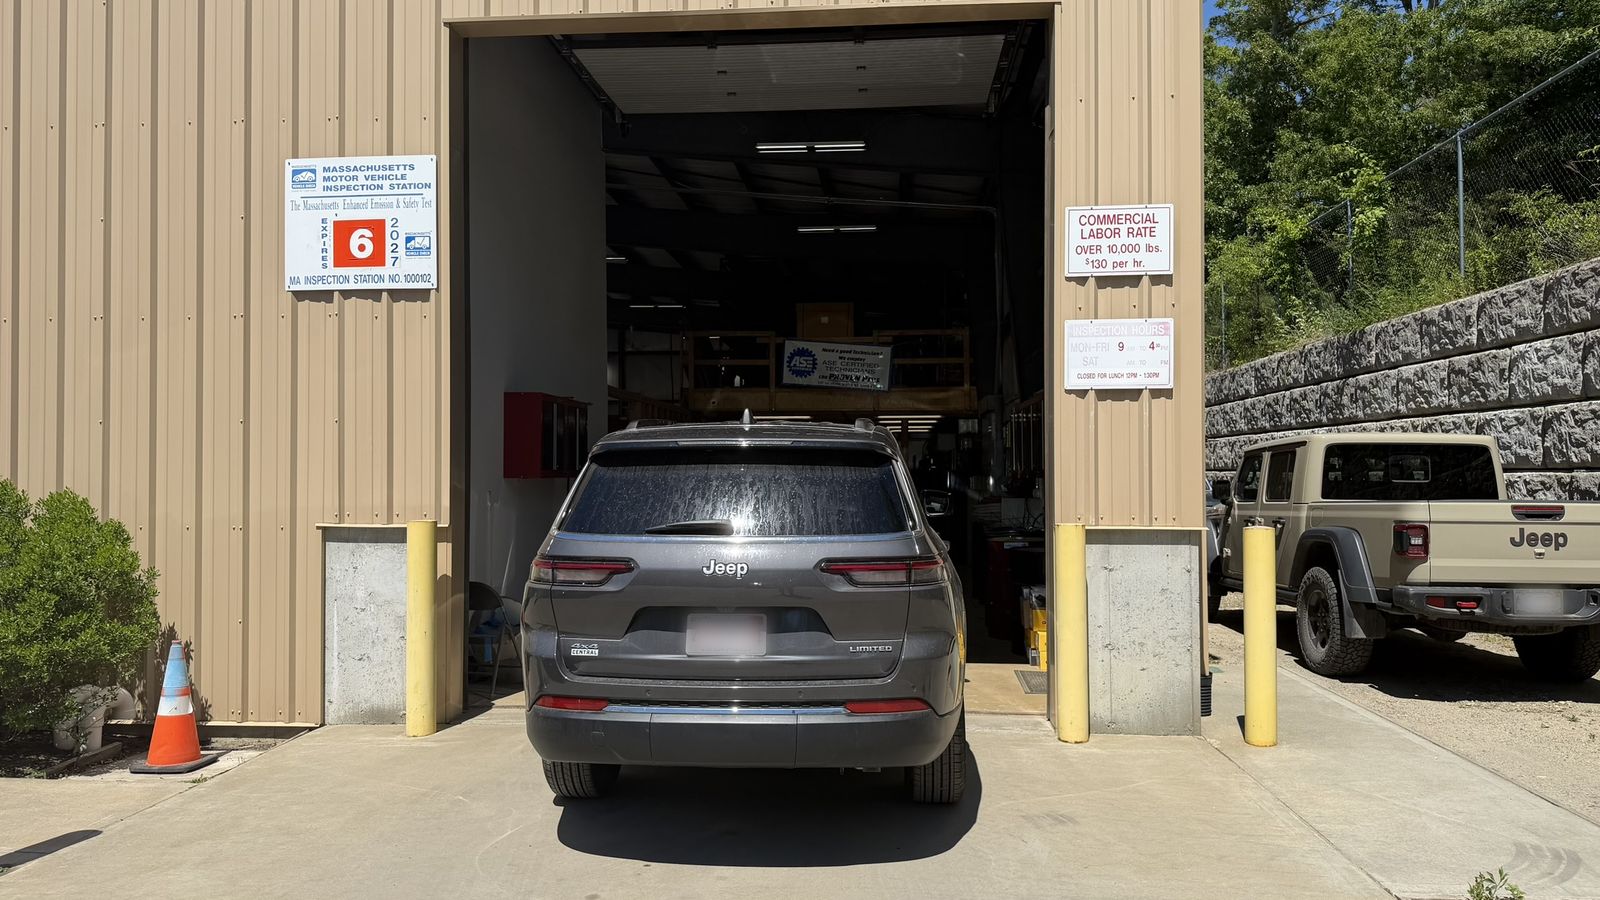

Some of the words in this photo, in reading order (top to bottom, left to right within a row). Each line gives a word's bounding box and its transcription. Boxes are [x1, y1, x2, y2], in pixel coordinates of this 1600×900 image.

[322, 164, 415, 173] MASSACHUSETTS
[322, 184, 384, 192] INSPECTION
[389, 182, 431, 190] STATION
[290, 200, 301, 211] The
[302, 199, 340, 211] Massachusetts
[342, 198, 369, 210] Enhanced
[370, 198, 394, 209] Emission
[402, 198, 420, 212] Safety
[421, 197, 432, 208] Test
[1078, 213, 1159, 226] COMMERCIAL
[1080, 228, 1121, 239] LABOR
[1127, 226, 1156, 238] RATE
[349, 228, 374, 259] 6
[390, 217, 400, 267] 2027
[1075, 245, 1102, 255] OVER
[1107, 243, 1141, 255] 10,000
[1145, 243, 1163, 253] lbs.
[1112, 261, 1128, 270] per
[1133, 258, 1145, 268] hr.
[289, 276, 301, 285] MA
[304, 275, 350, 284] INSPECTION
[353, 274, 385, 284] STATION
[388, 274, 403, 283] NO.
[404, 273, 432, 283] 1000102
[1071, 326, 1128, 336] INSPECTION
[1132, 324, 1165, 335] HOURS
[1070, 342, 1110, 353] MON-FRI
[1117, 341, 1125, 351] 9
[791, 356, 814, 368] ASE
[840, 361, 880, 369] CERTIFIED
[1083, 356, 1099, 366] SAT
[825, 366, 877, 374] TECHNICIANS
[1509, 527, 1568, 551] Jeep
[702, 559, 749, 579] Jeep
